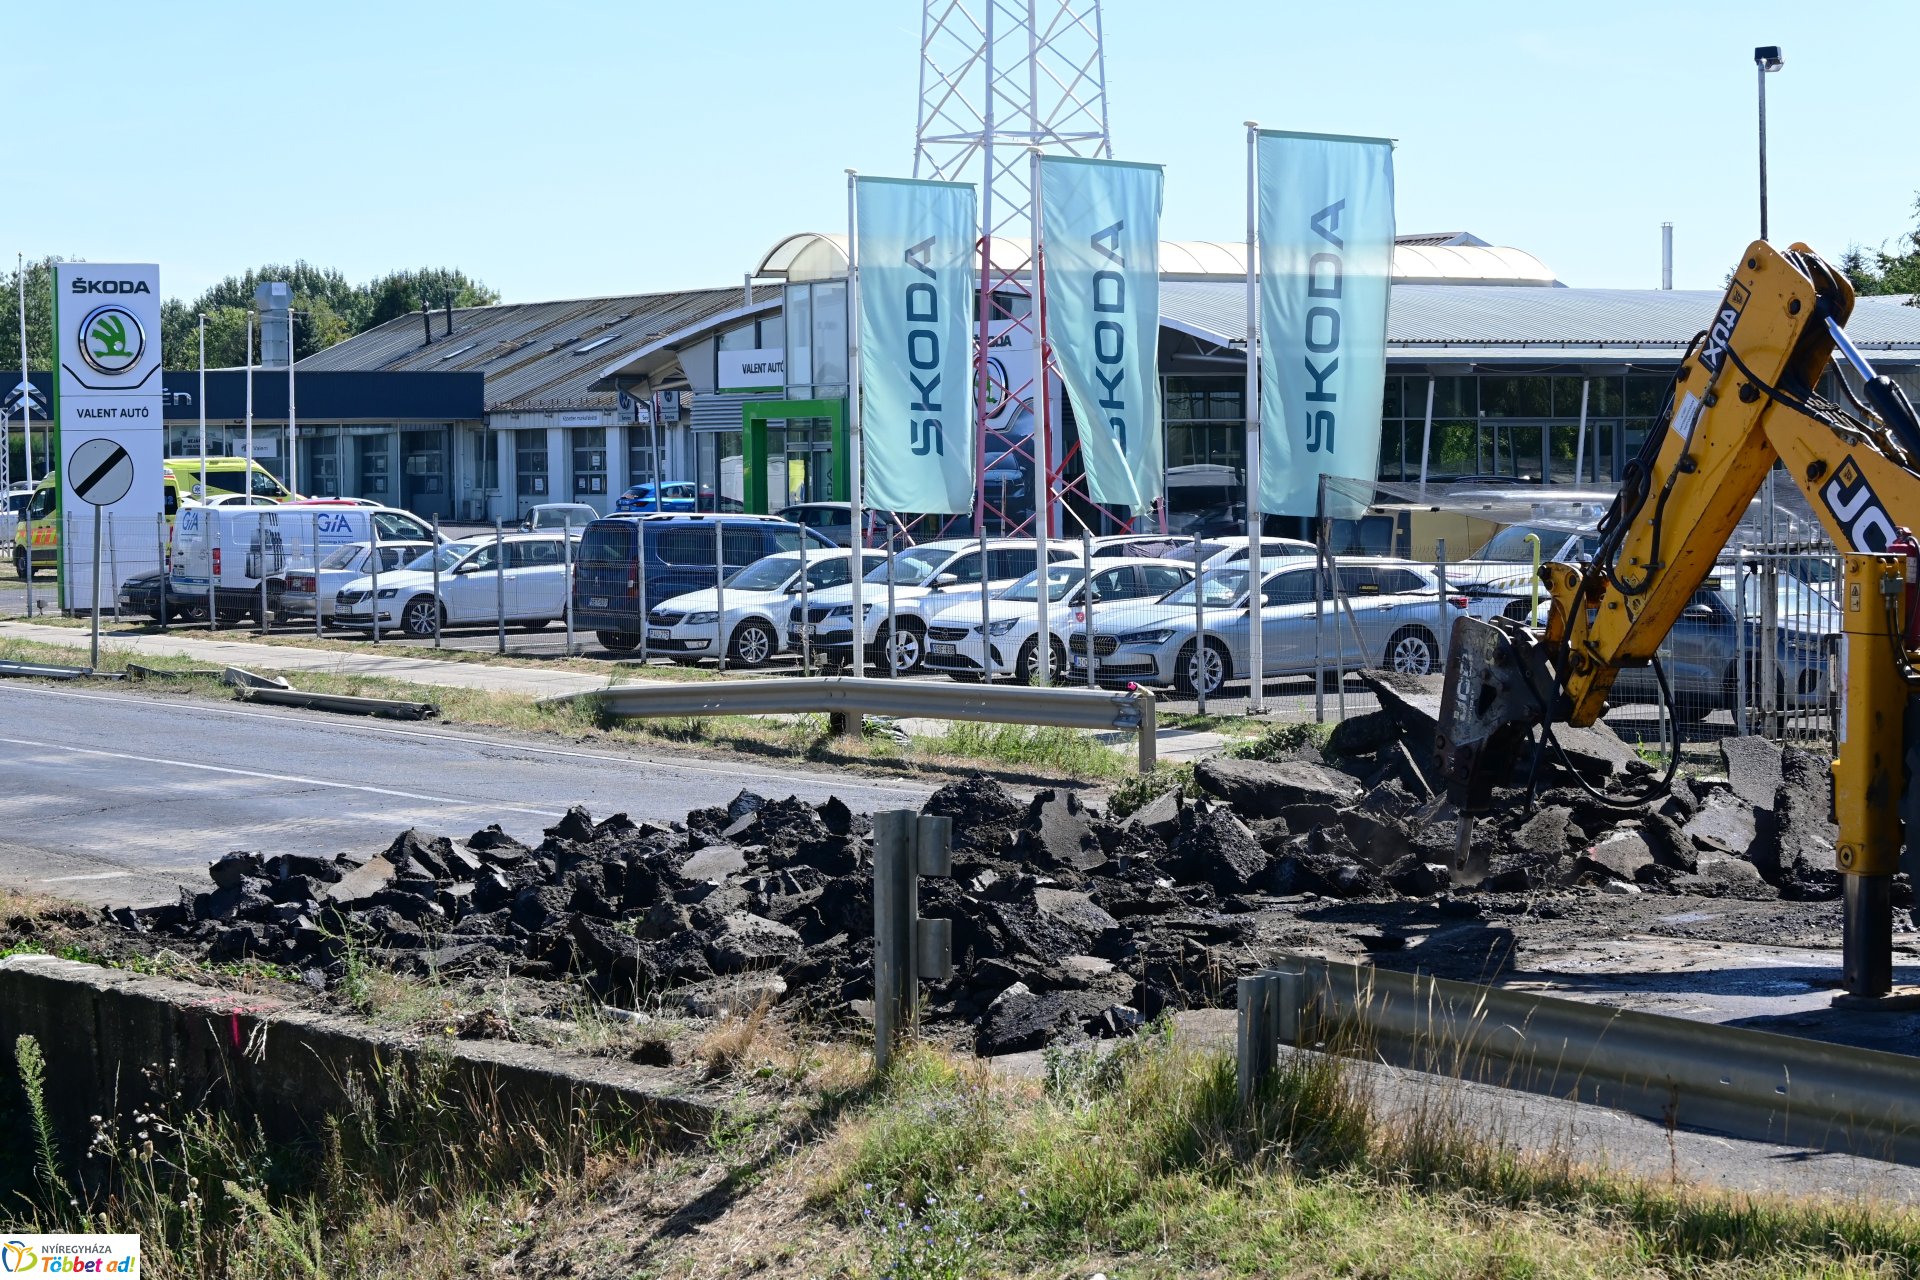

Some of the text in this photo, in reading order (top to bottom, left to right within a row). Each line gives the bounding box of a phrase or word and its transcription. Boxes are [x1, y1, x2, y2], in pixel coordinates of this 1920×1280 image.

[71, 277, 151, 295] ŠKODA
[742, 362, 767, 375] VALENT
[76, 406, 150, 419] VALENT AUTÓ
[1826, 479, 1898, 554] JC
